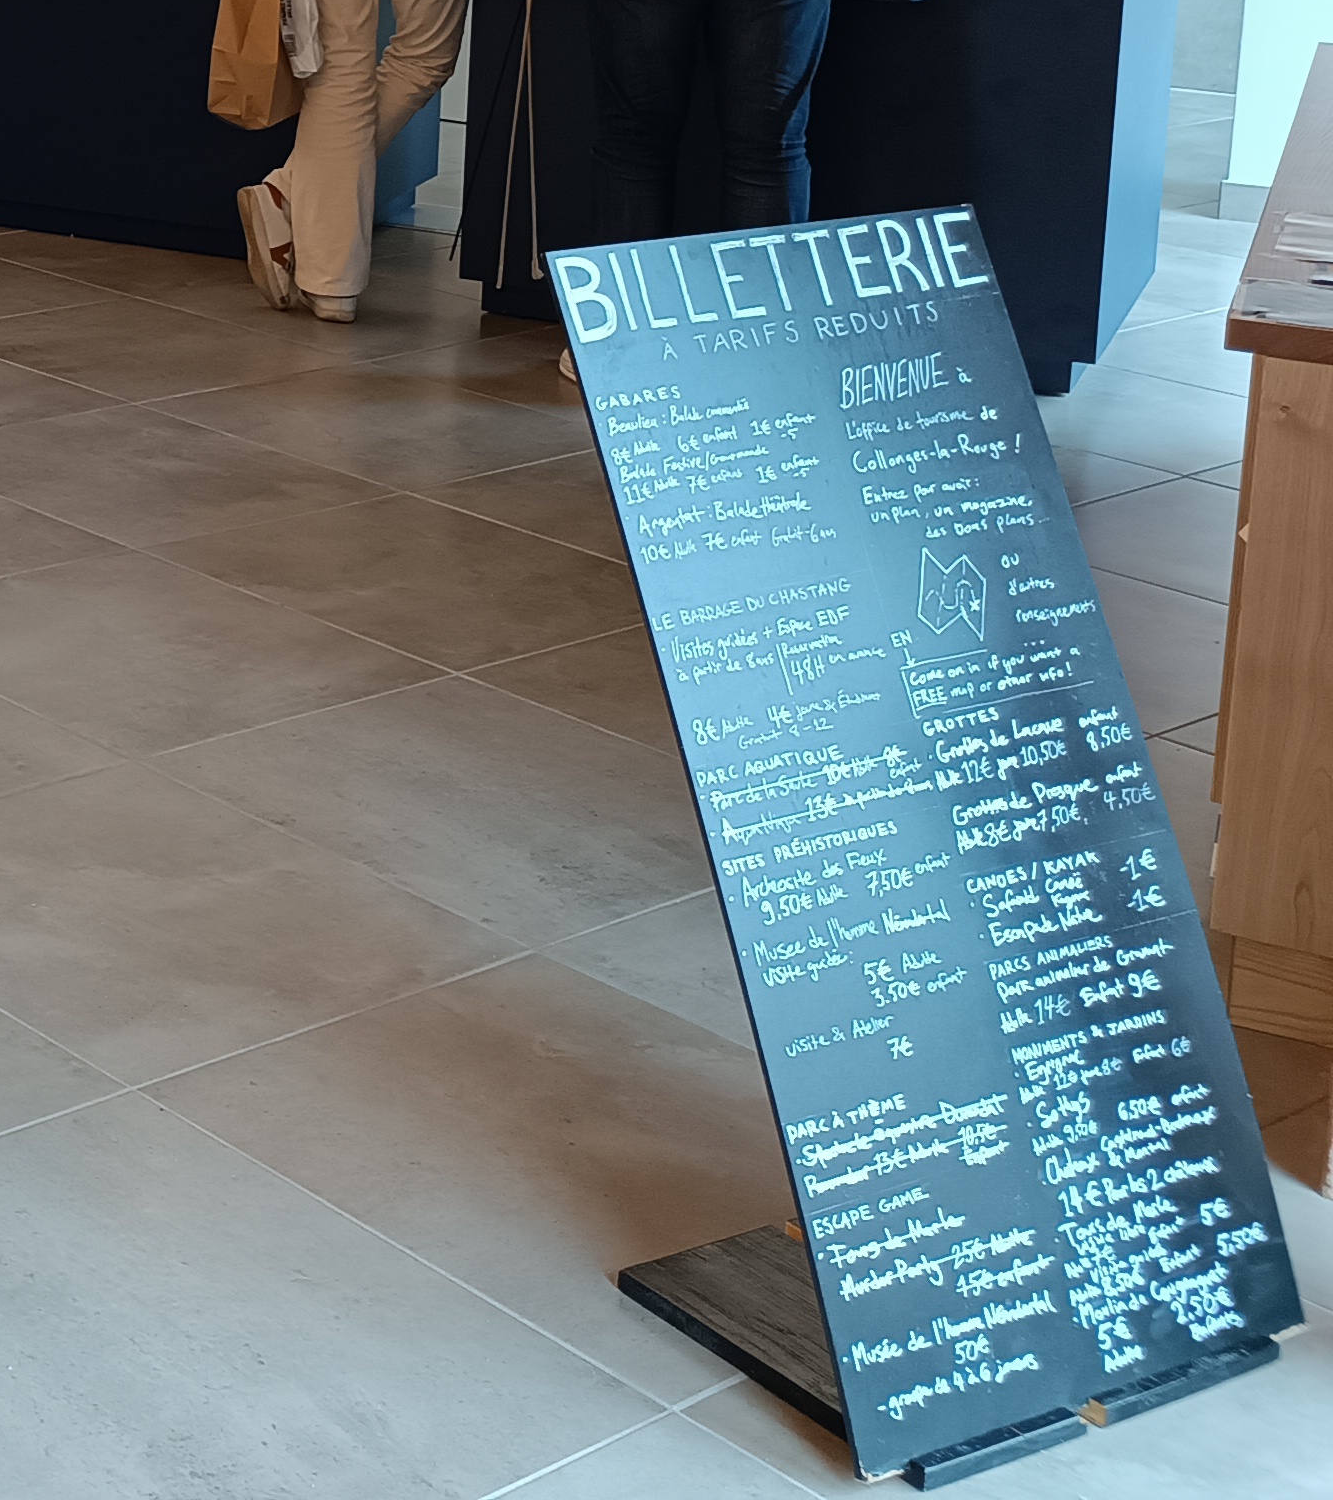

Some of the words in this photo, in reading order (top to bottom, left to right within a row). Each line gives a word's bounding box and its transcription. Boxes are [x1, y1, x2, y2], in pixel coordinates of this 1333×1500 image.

[554, 210, 990, 346] BILLETTERIE
[661, 337, 680, 362] À
[693, 318, 801, 354] TARIFS
[814, 301, 940, 341] REDUITS
[595, 385, 681, 411] GABARES
[839, 352, 949, 410] BIENVENUE
[956, 366, 972, 384] à
[896, 417, 913, 432] de
[916, 410, 975, 430] tourisme
[980, 405, 998, 420] de
[610, 448, 633, 465] 8€
[677, 435, 701, 453] 6€
[750, 420, 772, 436] 1€
[852, 433, 1007, 474] Collonges-la-Rouge
[623, 484, 655, 505] 11€
[686, 475, 710, 494] 7€
[756, 465, 778, 484] 1€
[861, 485, 909, 505] Entrez
[934, 506, 954, 517] un
[639, 545, 672, 565] 10€
[701, 533, 728, 551] 7€
[651, 613, 676, 633] LE
[679, 600, 743, 626] BARRAGE
[745, 596, 765, 613] DU
[768, 577, 852, 606] CHASTANG
[815, 605, 850, 628] EDF
[890, 629, 913, 649] EN
[726, 660, 742, 673] de
[909, 670, 945, 686] Come
[947, 665, 965, 678] on
[1001, 655, 1025, 675] you
[1030, 647, 1062, 663] want
[912, 686, 946, 708] FREE
[692, 718, 721, 746] 8€
[766, 705, 794, 729] 4€
[922, 706, 1000, 737] GROTTES
[990, 729, 1010, 748] de
[696, 765, 739, 788] PARC
[743, 744, 845, 777] AQUATIQUE
[962, 756, 994, 785] 12€
[1086, 722, 1133, 752] 8,50€
[1103, 782, 1156, 811] 4,50€
[721, 854, 765, 876] SITES
[773, 820, 899, 863] PRÉHISTORIQUES
[864, 868, 914, 898] 7,50€
[965, 866, 1029, 894] CANOES
[1043, 850, 1101, 875] KAYAK
[808, 926, 829, 949] de
[862, 958, 895, 985] 5€
[988, 955, 1031, 981] PARCS
[1036, 934, 1114, 966] ANIMALIERS
[1034, 994, 1072, 1026] 14€
[1127, 968, 1163, 999] 9€
[832, 1027, 846, 1042] &
[886, 1035, 914, 1060] 7€
[1011, 1030, 1088, 1065] MONUMENTS
[1106, 1009, 1168, 1035] JARDINS
[785, 1119, 830, 1145] PARC
[846, 1093, 906, 1126] THÈME
[812, 1204, 875, 1240] ESCAPE
[879, 1186, 930, 1214] GAME
[1057, 1181, 1104, 1218] 14€
[1199, 1197, 1232, 1227] 5€
[954, 1333, 990, 1364] 50€
[1097, 1316, 1133, 1350] 5€
